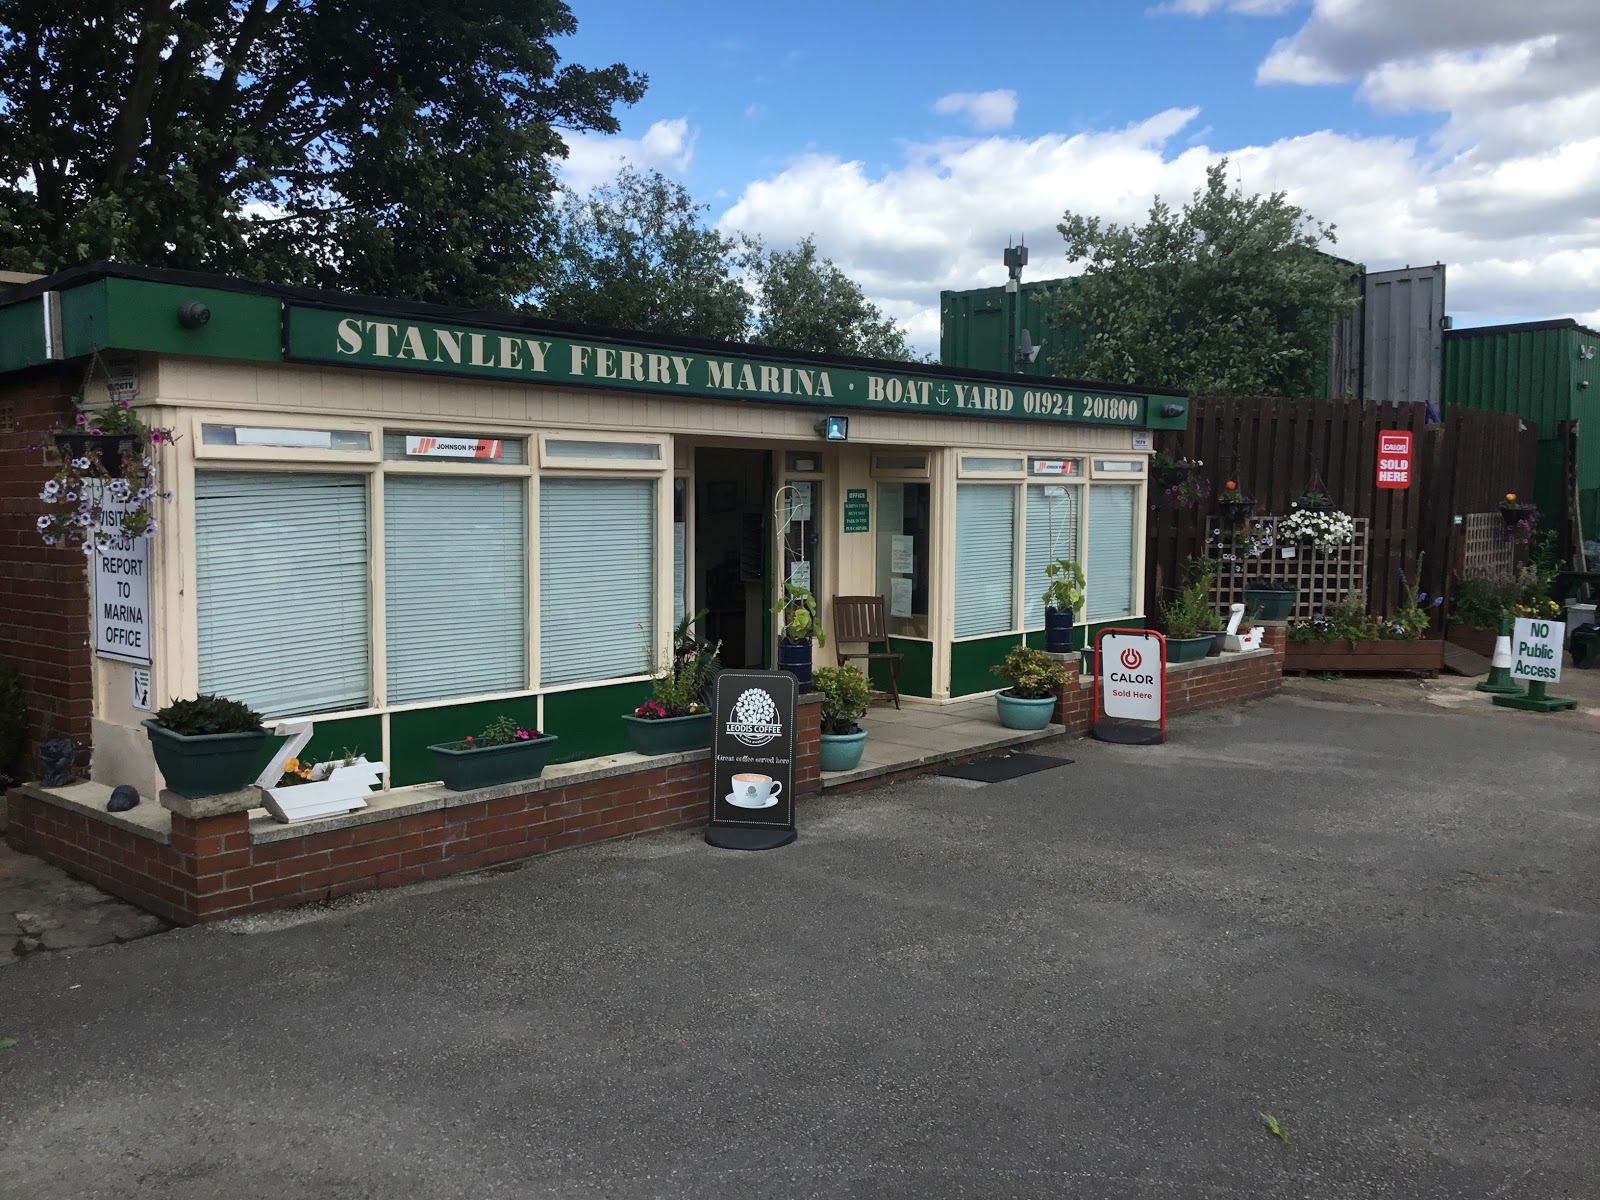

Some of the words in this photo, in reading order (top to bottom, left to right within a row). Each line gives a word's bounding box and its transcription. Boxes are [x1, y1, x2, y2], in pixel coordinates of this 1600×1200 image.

[336, 318, 552, 373] STANLEY
[569, 344, 694, 386] FERRY
[706, 360, 834, 398] MARINA
[867, 376, 933, 405] BOAT
[954, 384, 1014, 412] YARD
[1023, 391, 1074, 416] 01924
[1083, 395, 1138, 421] 201800
[437, 443, 467, 451] JOHNSON
[1380, 459, 1408, 470] SOLD
[1379, 471, 1408, 482] HERE
[102, 556, 143, 576] REPORT
[117, 581, 131, 599] TO
[104, 603, 143, 625] MARINA
[106, 626, 141, 648] OFFICE
[1530, 622, 1549, 639] NO
[1519, 641, 1554, 660] Public
[1514, 659, 1556, 679] Access
[1110, 672, 1154, 685] CALOR
[1112, 689, 1131, 698] Sold
[1133, 691, 1152, 699] Here
[726, 724, 753, 733] LEODIS
[754, 725, 781, 734] COFFEE
[717, 753, 735, 762] Great
[736, 755, 754, 763] coffee
[755, 756, 774, 764] served
[775, 757, 790, 765] here
